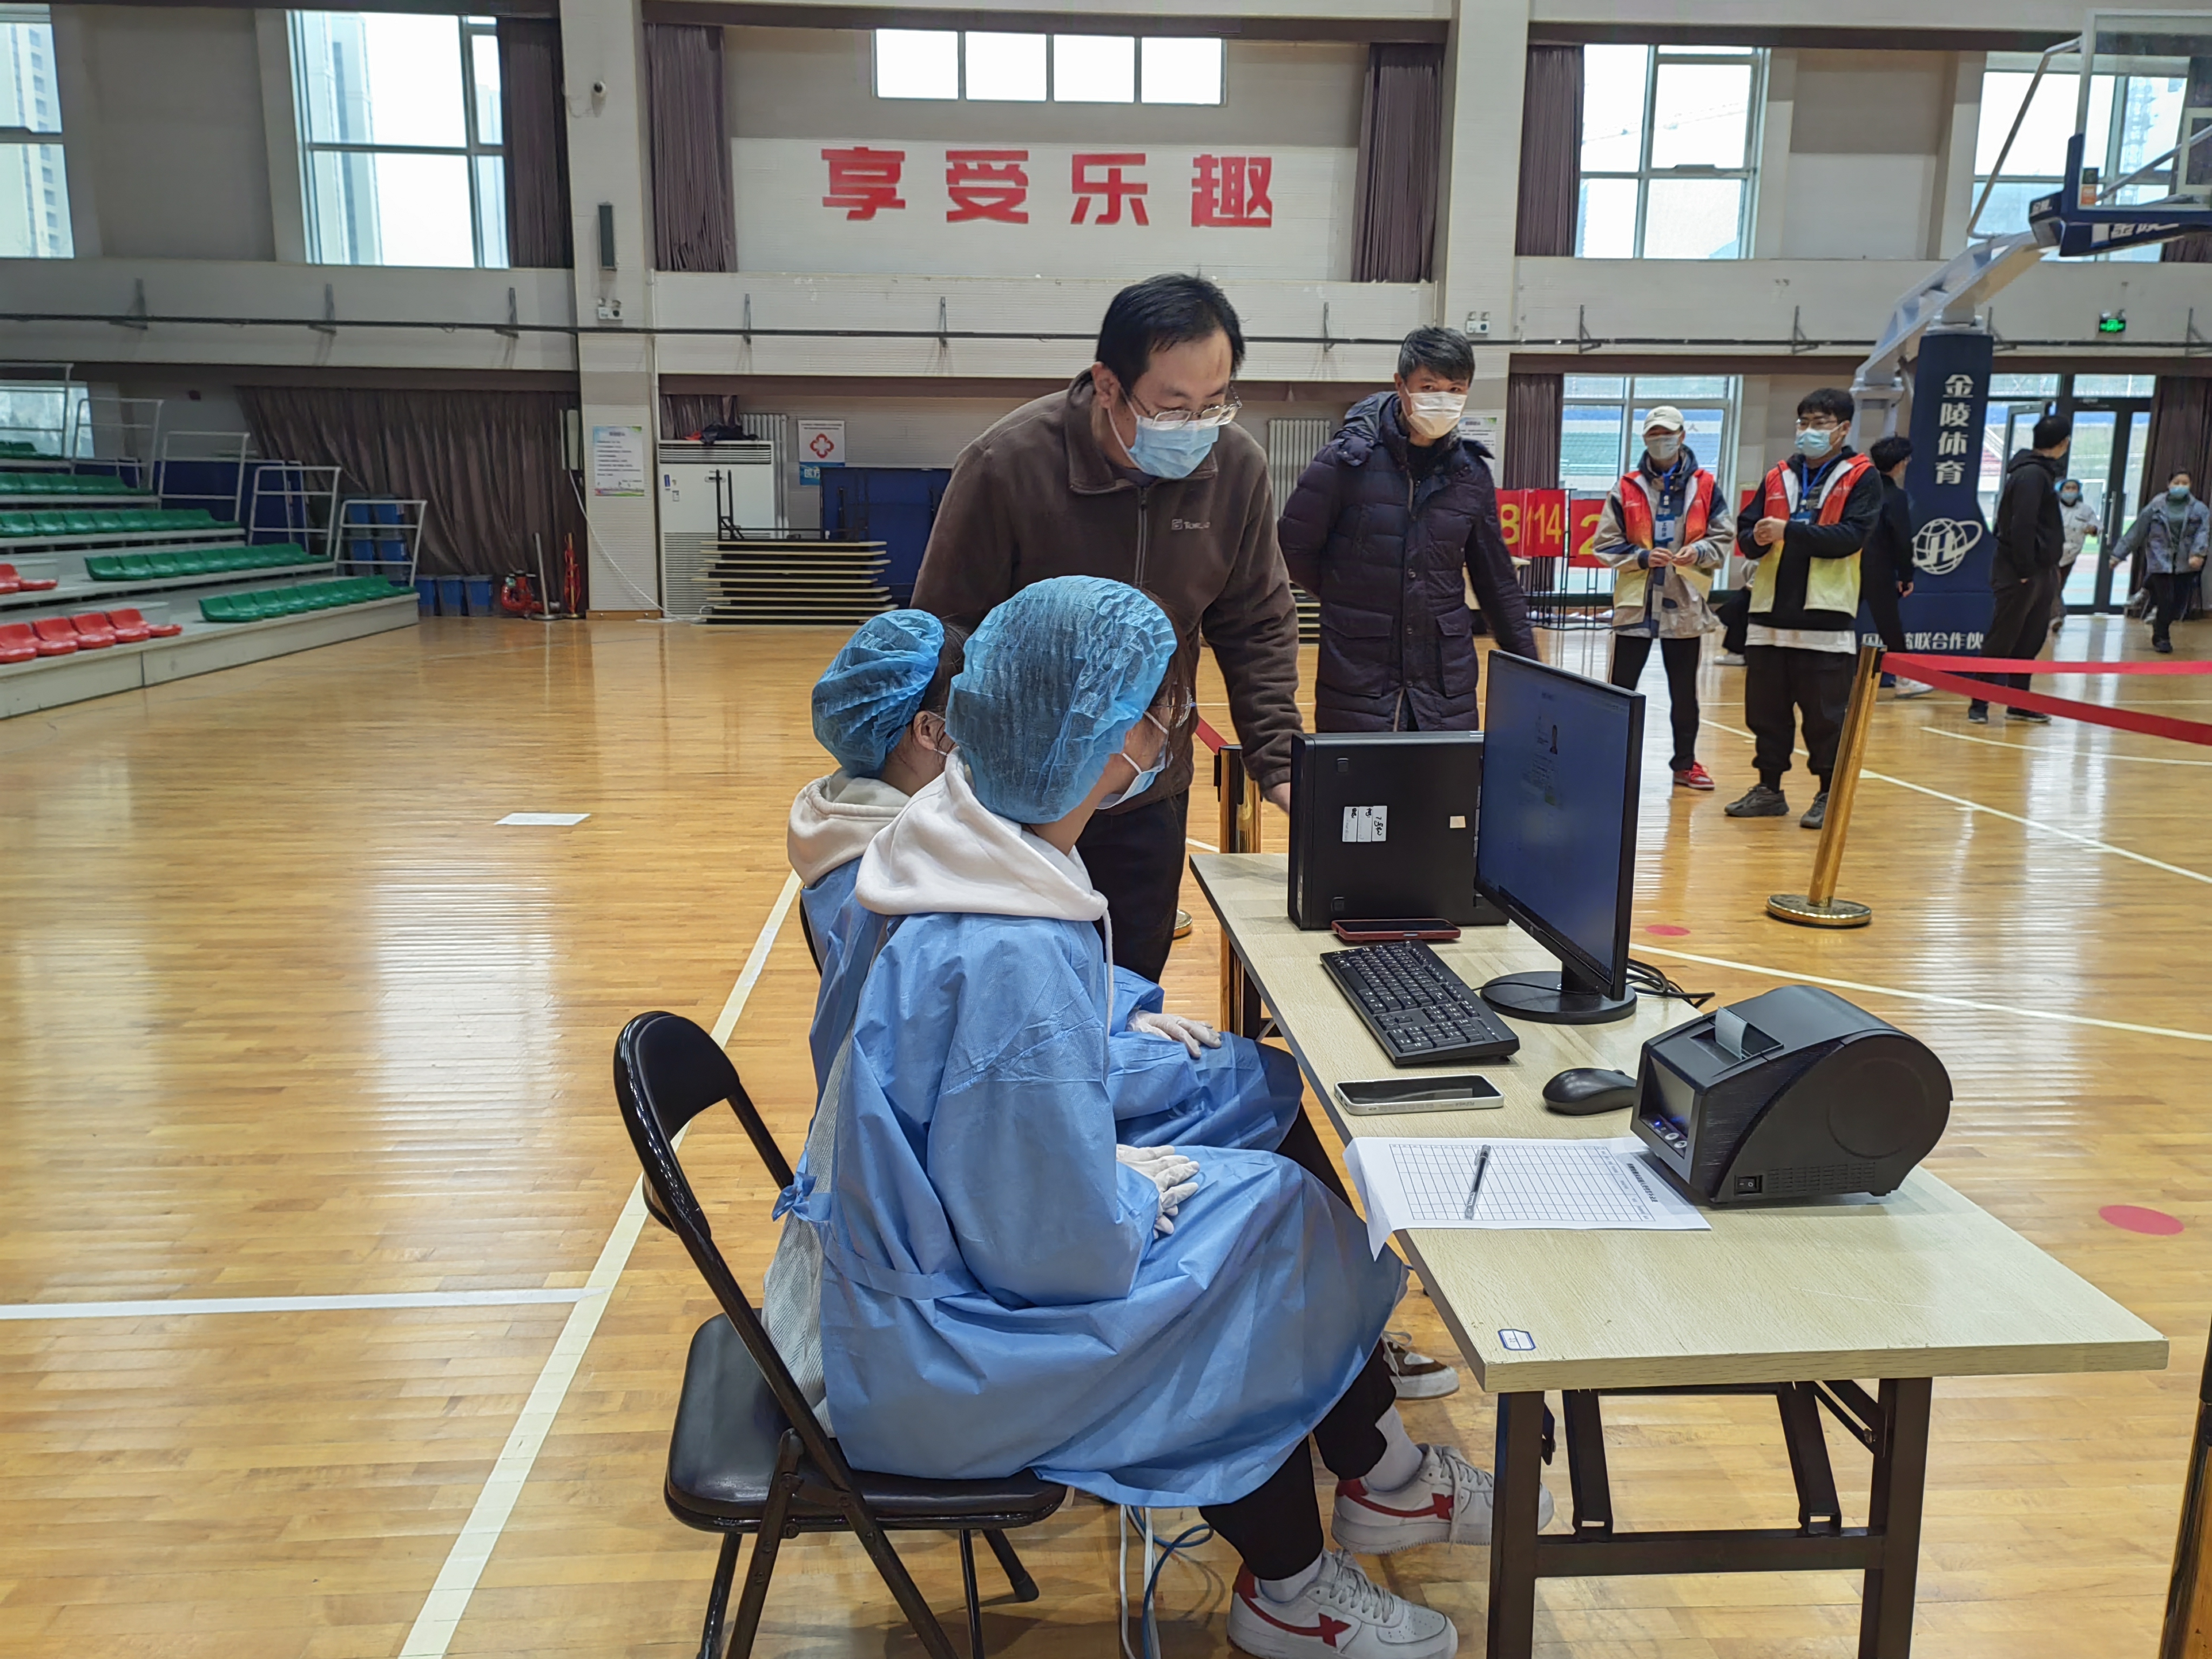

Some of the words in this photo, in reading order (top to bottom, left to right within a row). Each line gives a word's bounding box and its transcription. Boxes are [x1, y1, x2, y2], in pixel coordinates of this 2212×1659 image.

[821, 146, 1273, 227] 享受乐趣
[1936, 374, 1974, 484] 金陵体育
